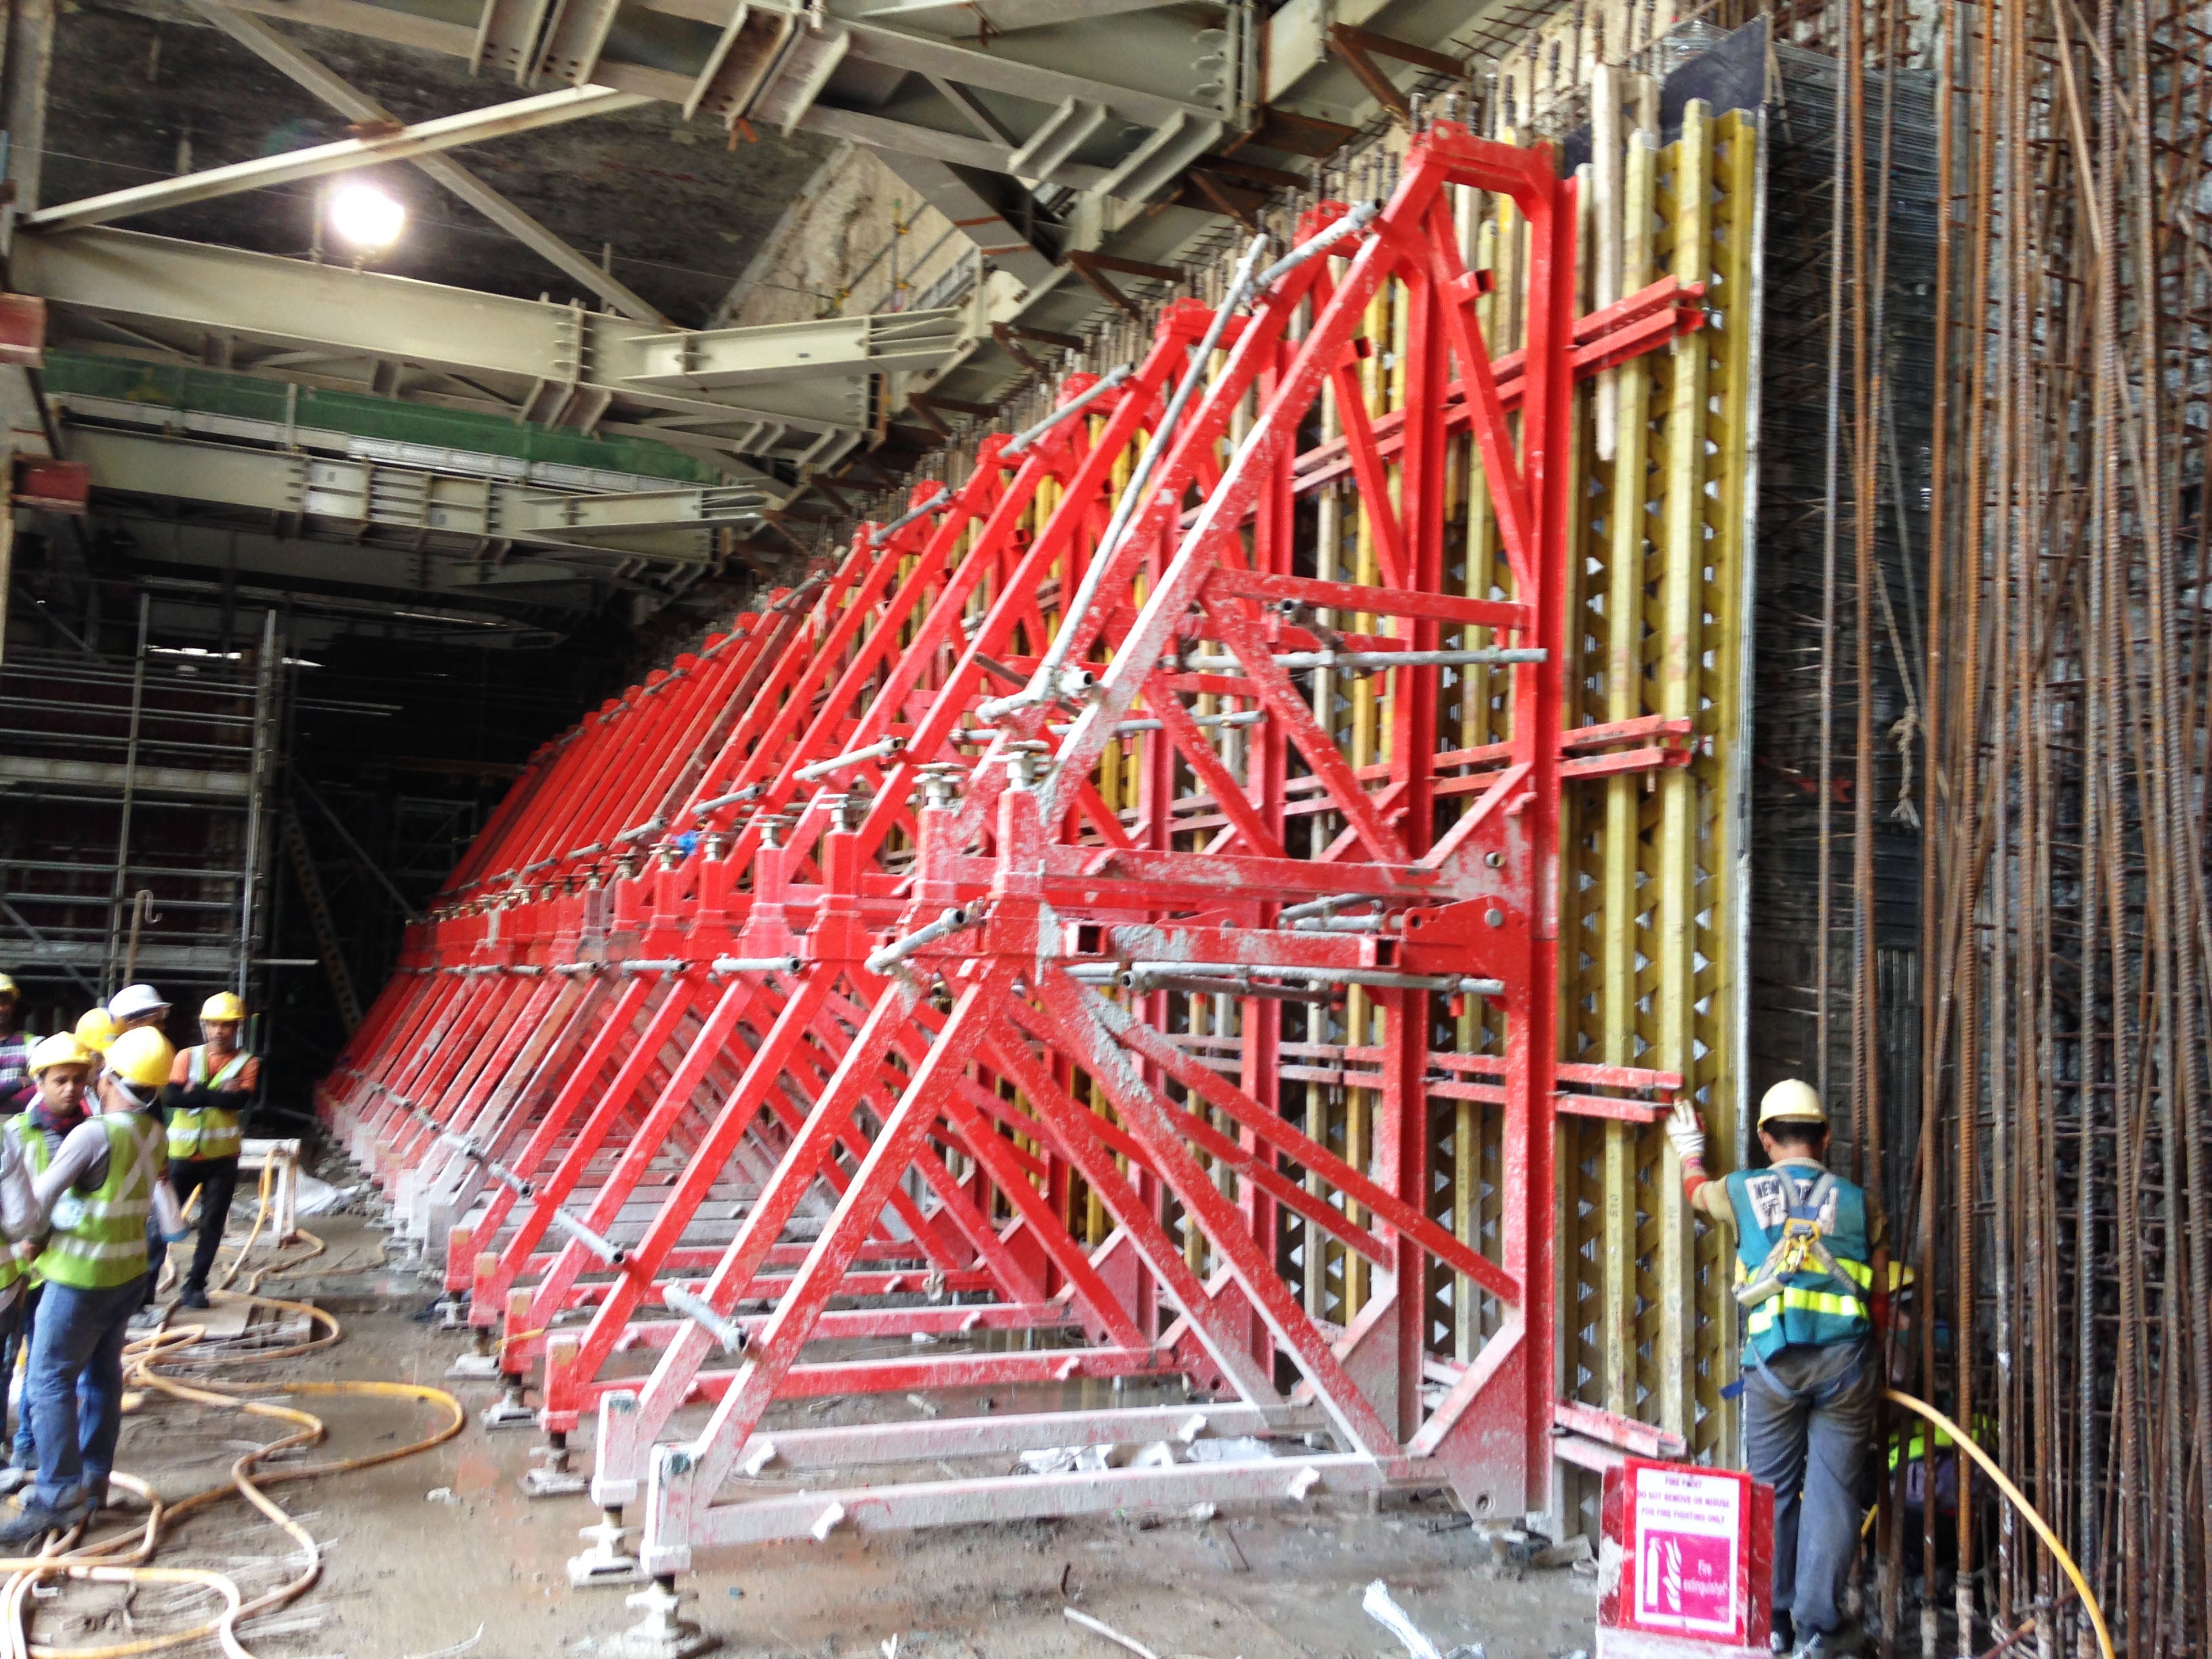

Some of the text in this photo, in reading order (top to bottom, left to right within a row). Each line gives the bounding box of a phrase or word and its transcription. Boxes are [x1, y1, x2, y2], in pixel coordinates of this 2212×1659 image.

[1754, 1179, 1780, 1199] NEW
[1665, 1477, 1680, 1486] FIRE
[1637, 1489, 1647, 1498] DO
[1648, 1492, 1662, 1500] NOT
[1664, 1494, 1692, 1504] REMOVE
[1694, 1496, 1702, 1505] OR
[1641, 1507, 1725, 1524] FOR FIRE FIGHTING ONLY
[1698, 1559, 1713, 1577] Fire
